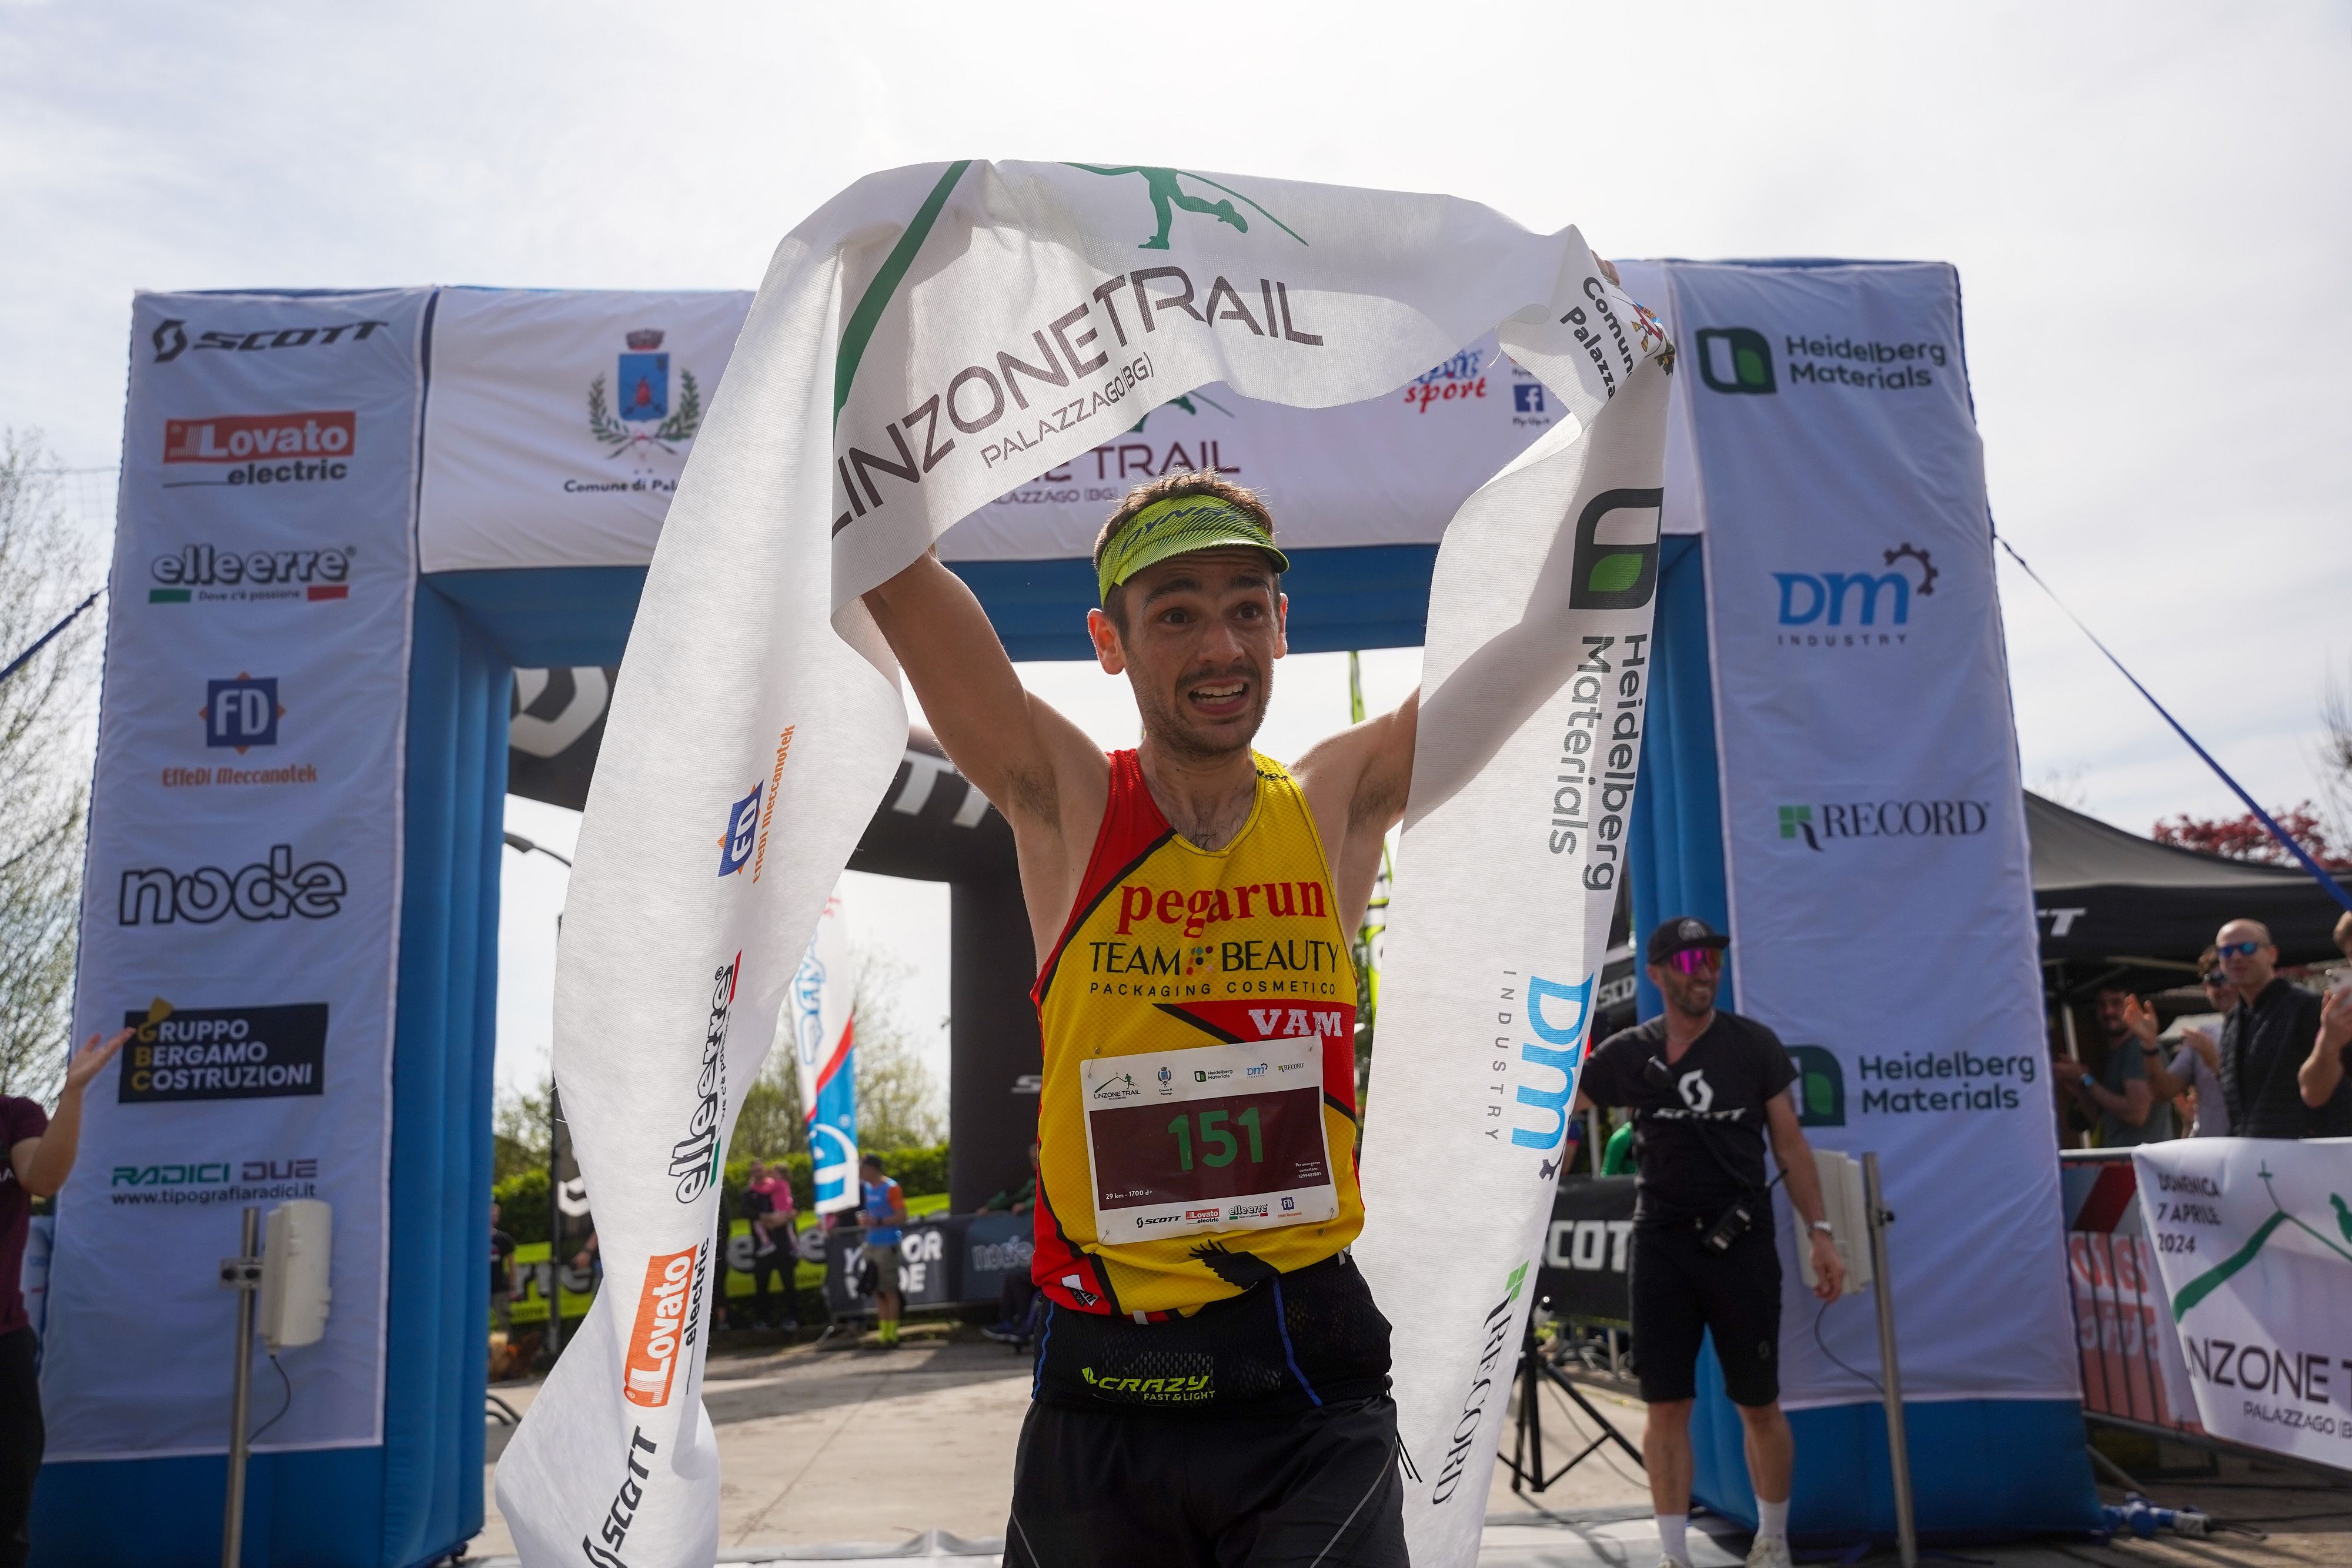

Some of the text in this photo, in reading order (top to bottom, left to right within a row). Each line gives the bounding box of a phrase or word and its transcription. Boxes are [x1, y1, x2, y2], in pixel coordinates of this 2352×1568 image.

[193, 320, 389, 351] SCOTT
[1583, 277, 1633, 381] Comun
[1560, 306, 1615, 400] Palazza
[1786, 335, 1946, 367] Heidelberg
[1790, 362, 1933, 390] Materials
[1404, 376, 1486, 413] sport
[199, 420, 348, 457] Lovato
[228, 460, 347, 485] electric
[1091, 440, 1240, 480] TRAIL
[564, 479, 628, 493] Comune
[632, 478, 646, 492] di
[1778, 634, 1907, 647] INDUSTRY
[1549, 636, 1615, 855] Materials
[1582, 634, 1648, 891] Heidelberg
[1822, 800, 1987, 838] RECORD
[1115, 881, 1327, 938] pegarun
[1090, 939, 1339, 976] TEAM BEAUTY
[1090, 980, 1336, 998] PACKAGING COSMETICO
[137, 1019, 250, 1043] GRUPPO
[1248, 1008, 1343, 1038] VAM
[135, 1040, 269, 1067] BERGAMO
[1485, 969, 1517, 1141] INDUSTRY
[1858, 1051, 2035, 1083] Heidelberg
[131, 1062, 313, 1092] COSTRUZIONI
[1862, 1084, 2019, 1114] Materials
[1168, 1106, 1265, 1172] 151
[112, 1159, 318, 1186] RADICI DUE
[112, 1182, 316, 1205] www.tipografiaradici.it
[1144, 1215, 1181, 1225] SCOTT
[1191, 1210, 1219, 1218] Lovato
[2157, 1202, 2222, 1226] 7 APRILE
[1546, 1219, 1635, 1273] COT
[2158, 1233, 2196, 1253] 2024
[684, 1236, 709, 1347] electric
[629, 1255, 691, 1375] Lovato
[1098, 1375, 1210, 1393] CRAZY
[1183, 1390, 1215, 1401] LIGHT
[1433, 1308, 1514, 1505] RECORD
[2243, 1400, 2335, 1435] PALAZZAGO
[602, 1425, 657, 1553] SCOTT
